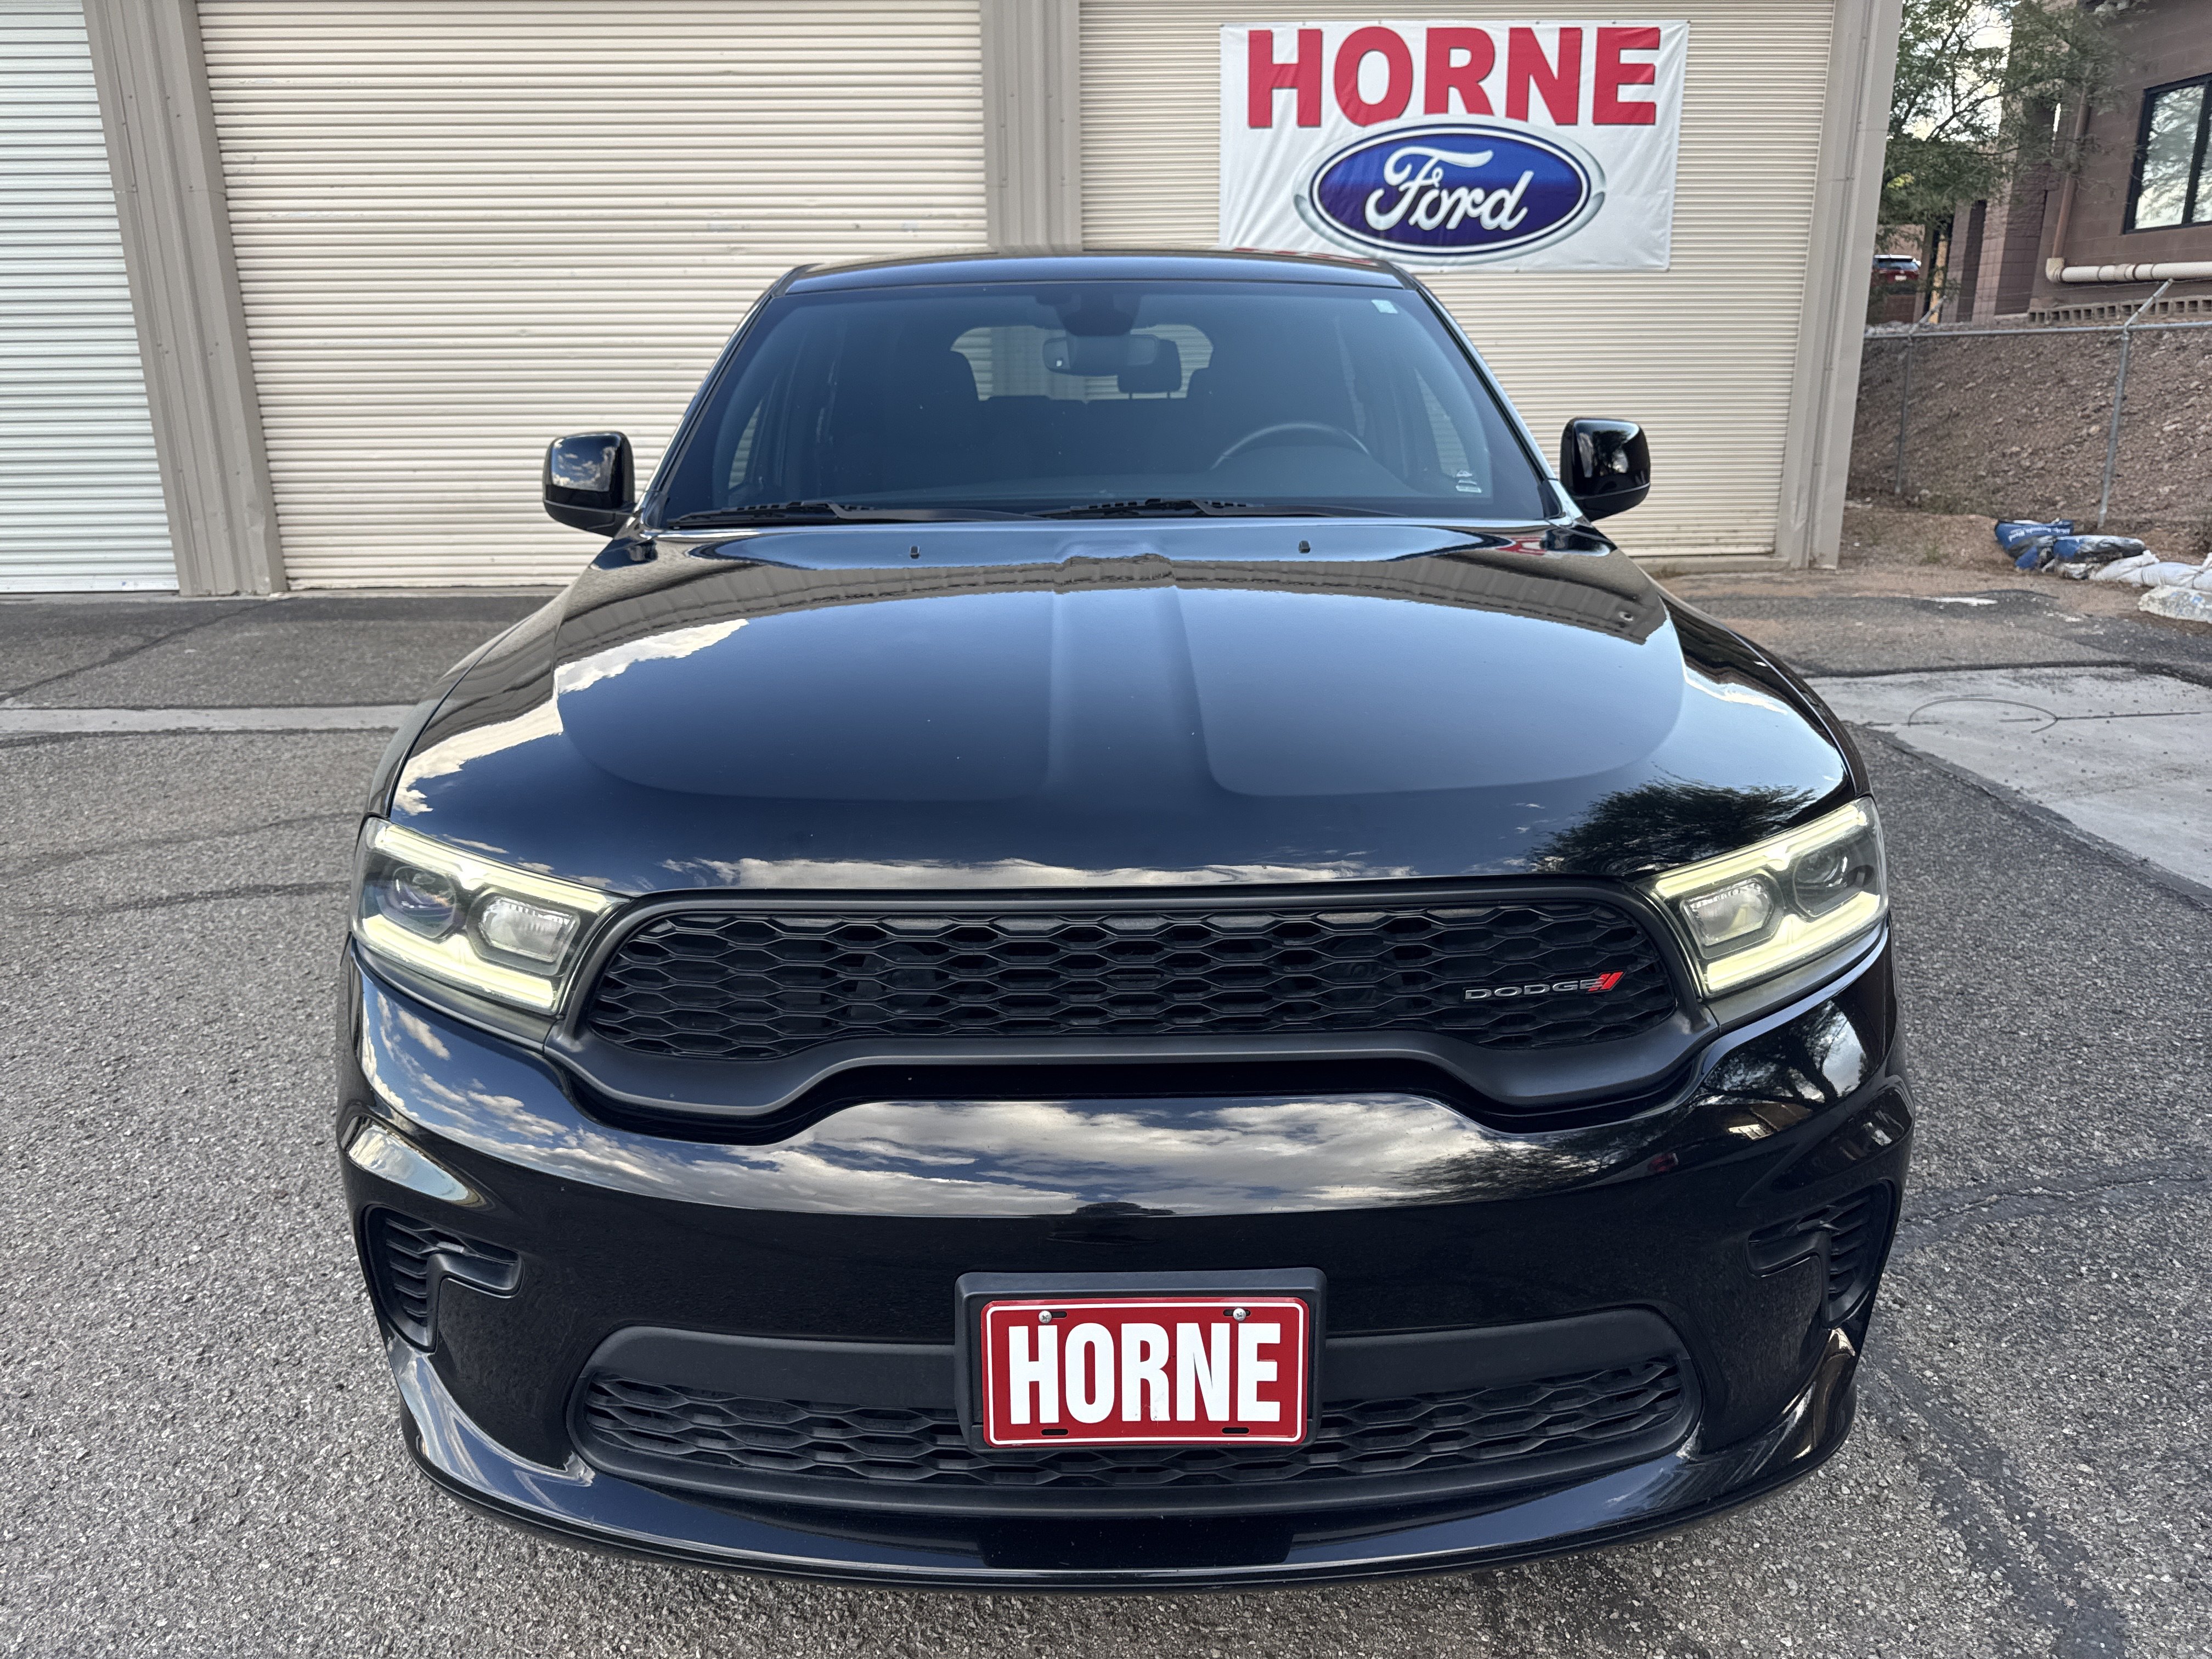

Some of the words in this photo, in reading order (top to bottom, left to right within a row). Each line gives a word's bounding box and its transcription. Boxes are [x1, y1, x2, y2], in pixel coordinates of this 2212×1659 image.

[1248, 26, 1660, 128] HORNE
[1364, 146, 1534, 231] Ford
[1465, 977, 1604, 1000] DODGE
[1008, 1322, 1281, 1425] HORNE
